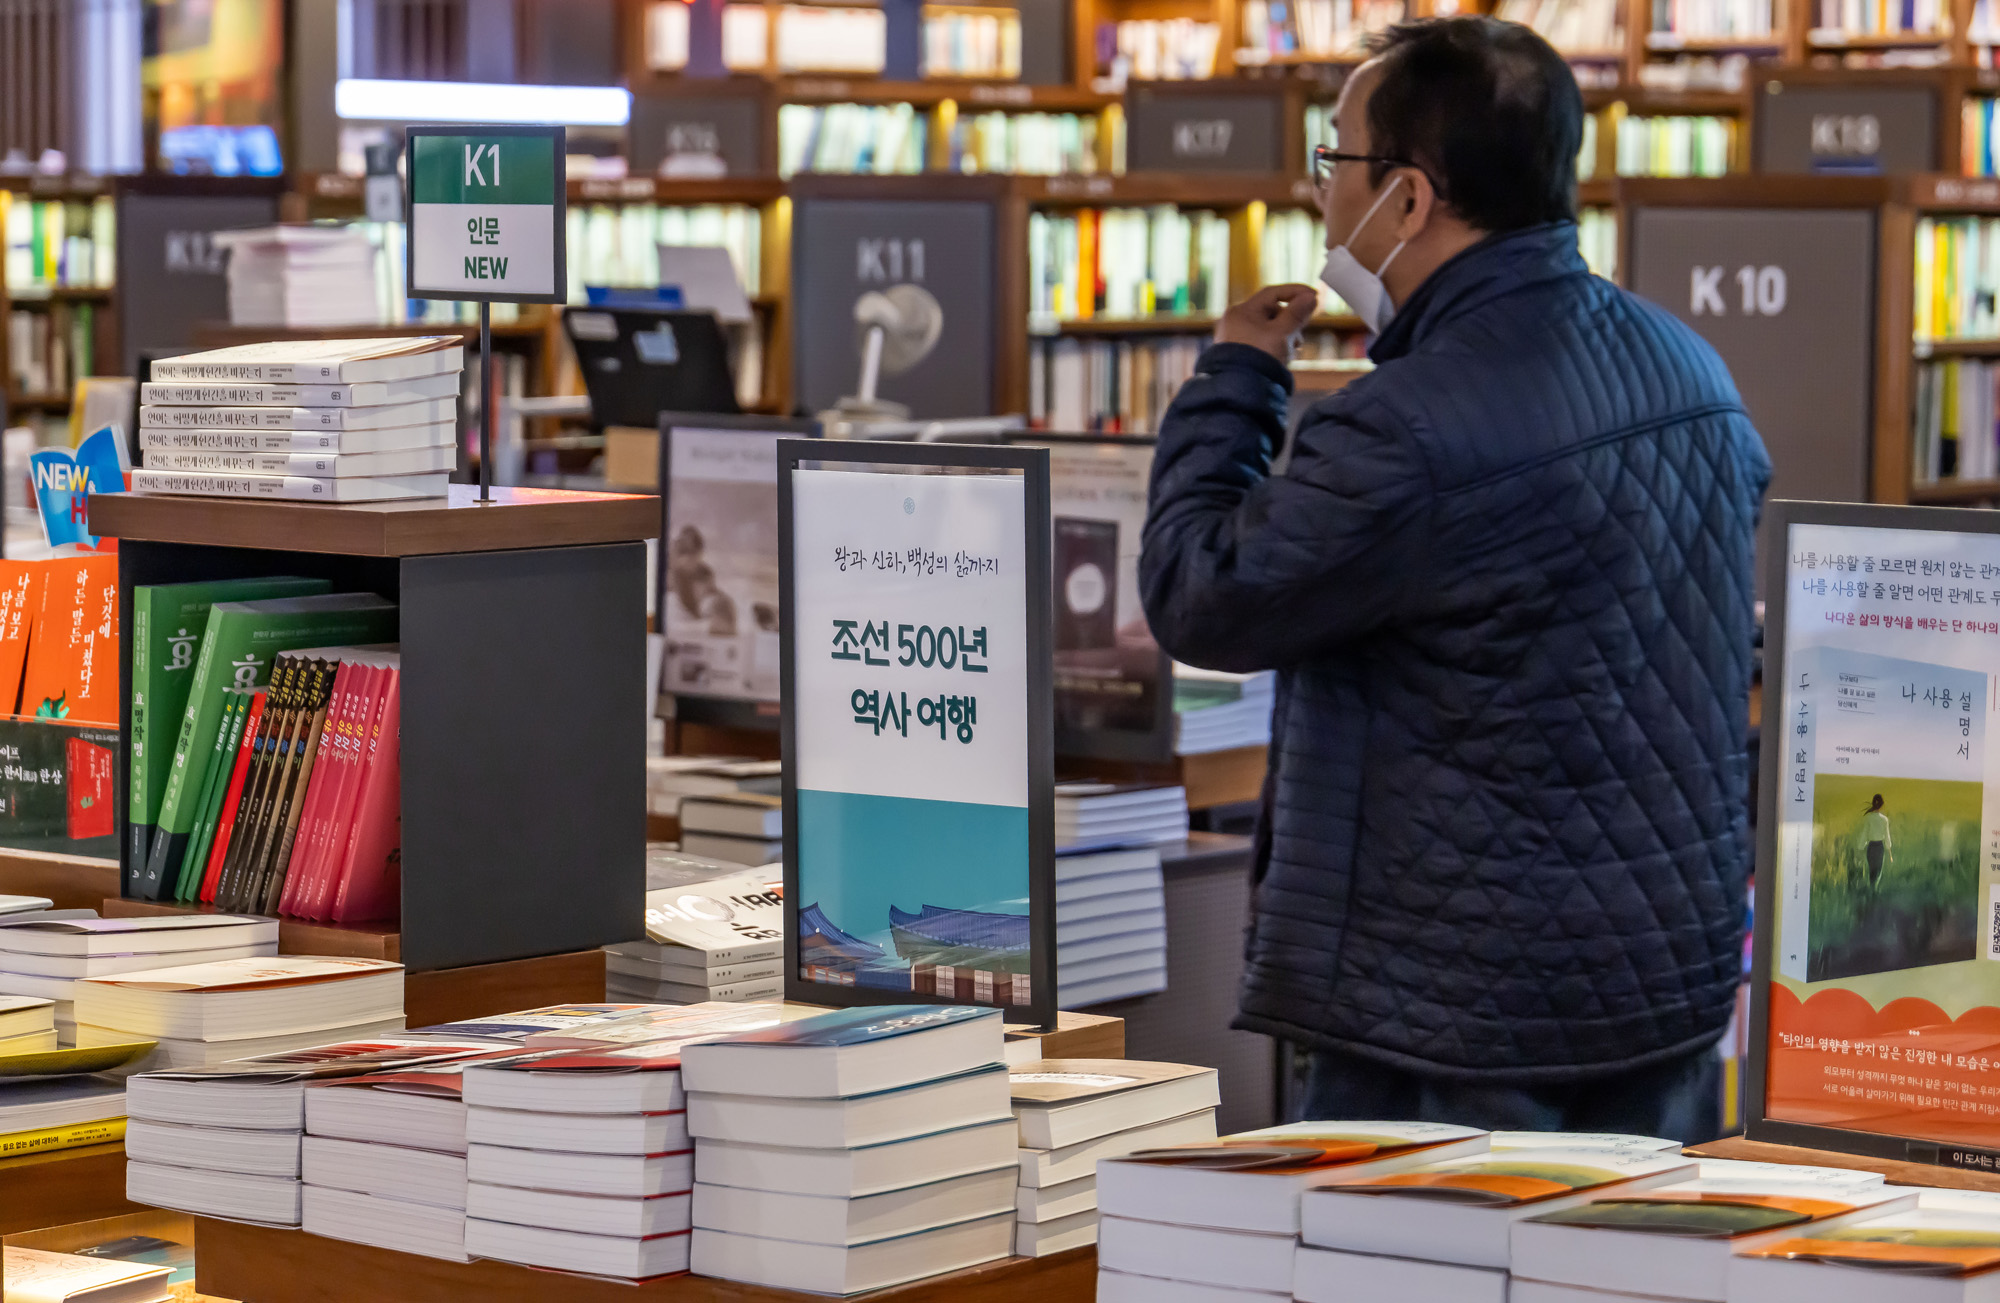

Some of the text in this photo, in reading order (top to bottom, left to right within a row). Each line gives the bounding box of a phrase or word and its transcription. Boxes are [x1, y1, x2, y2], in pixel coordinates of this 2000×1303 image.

[464, 143, 501, 187] K1
[467, 216, 501, 245] 인문
[464, 256, 509, 280] NEW
[857, 237, 925, 282] K11
[37, 461, 90, 493] NEW
[835, 546, 867, 572] 왕과
[1793, 551, 1819, 569] 나를
[1820, 554, 1860, 573] 사용할
[1862, 556, 1876, 573] 줄
[1878, 558, 1918, 576] 모르면
[1920, 559, 1946, 577] 원치
[1949, 561, 1977, 580] 않는
[6, 572, 31, 641] 나를 보고
[1802, 577, 1829, 597] 나를
[1830, 580, 1870, 599] 사용할
[1872, 582, 1886, 600] 줄
[1889, 584, 1915, 602] 알면
[1917, 585, 1944, 604] 어떤
[1947, 587, 1987, 606] 관계도
[98, 584, 116, 640] 단것에
[1825, 610, 1999, 636] 나다운 삶의 방식을 배우는 단 하나의
[163, 628, 198, 672] 효
[830, 619, 989, 674] 조선 500년
[222, 653, 265, 693] 효
[1901, 682, 1917, 704] 나
[1923, 686, 1953, 710] 사용
[850, 688, 977, 745] 역사 여행
[1818, 1037, 1851, 1055] 영향을
[1854, 1041, 1876, 1058] 받지
[1879, 1045, 1902, 1061] 않은
[1904, 1048, 1938, 1065] 진정한
[1941, 1052, 1953, 1067] 내
[1955, 1055, 1990, 1072] 모습은
[1823, 1065, 1855, 1080] 외모부터
[1856, 1069, 1888, 1084] 성격까지
[1889, 1073, 1906, 1086] 무엇
[1907, 1076, 1924, 1088] 하나
[1925, 1078, 1942, 1091] 같은
[1943, 1080, 1960, 1093] 것이
[1961, 1082, 1978, 1096] 없는
[1822, 1082, 1839, 1095] 서로
[1865, 1088, 1898, 1103] 살아가기
[1899, 1092, 1916, 1104] 위해
[1917, 1094, 1941, 1108] 필요한
[1960, 1100, 1977, 1113] 관계
[1952, 1151, 1963, 1165] 이
[1964, 1153, 1993, 1167] 도서는
